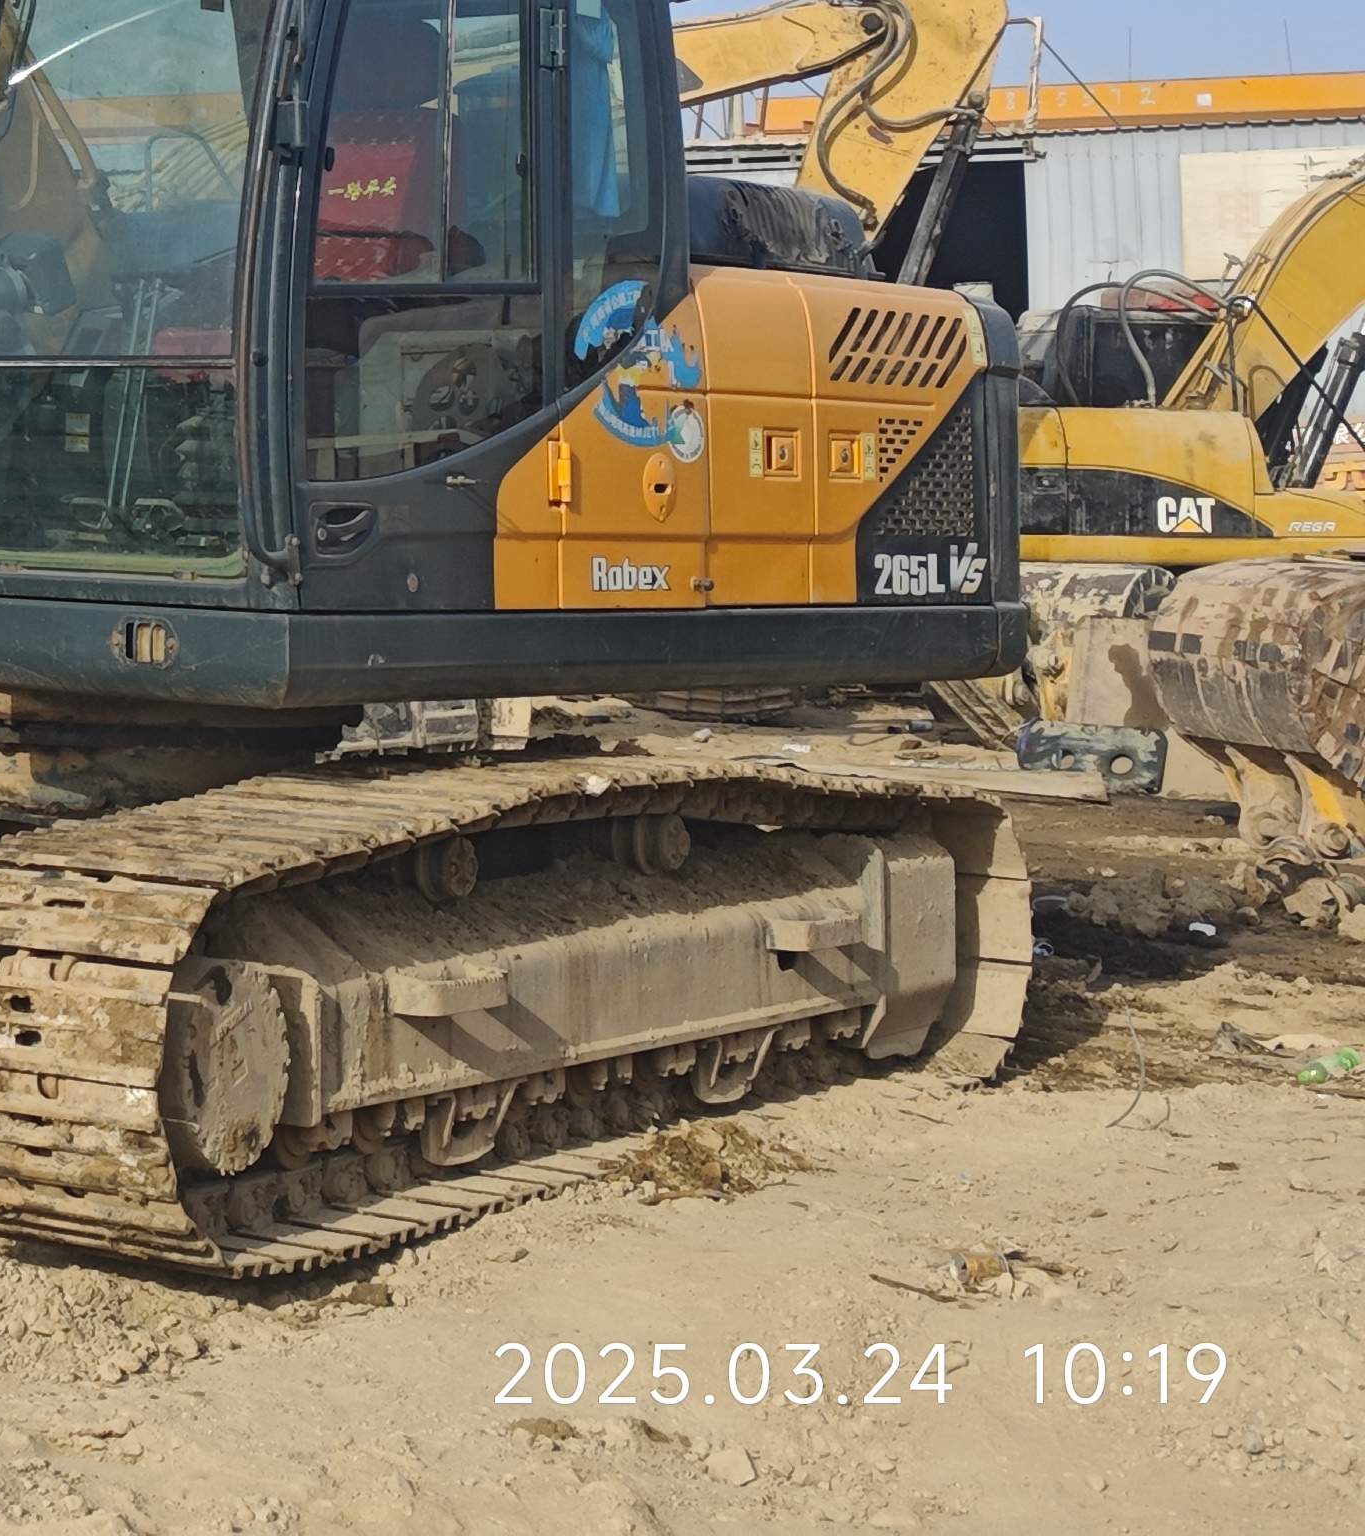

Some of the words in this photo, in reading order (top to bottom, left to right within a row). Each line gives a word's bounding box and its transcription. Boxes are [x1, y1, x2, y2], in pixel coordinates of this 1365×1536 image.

[1157, 496, 1216, 533] CAT
[1288, 521, 1336, 533] REGA
[591, 556, 671, 591] Robex
